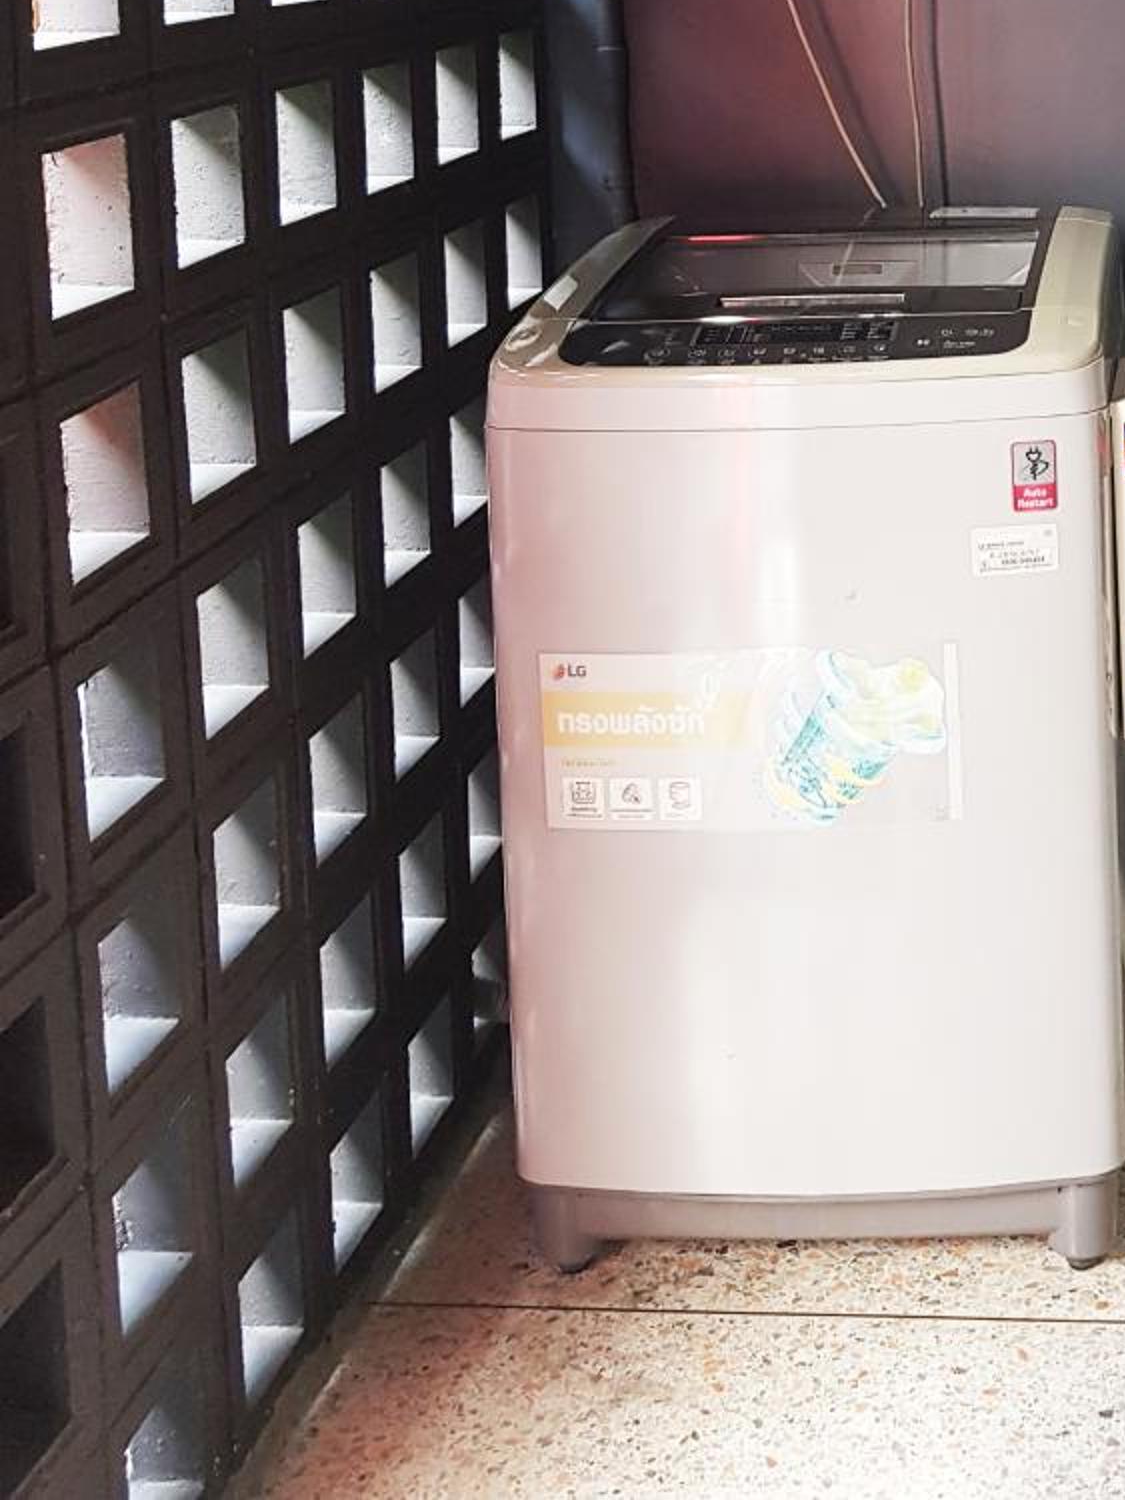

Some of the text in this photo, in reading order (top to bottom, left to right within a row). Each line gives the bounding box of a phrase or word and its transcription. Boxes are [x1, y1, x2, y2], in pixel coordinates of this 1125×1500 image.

[1023, 487, 1048, 498] Auto
[1017, 498, 1054, 510] Restart
[567, 665, 587, 678] LG
